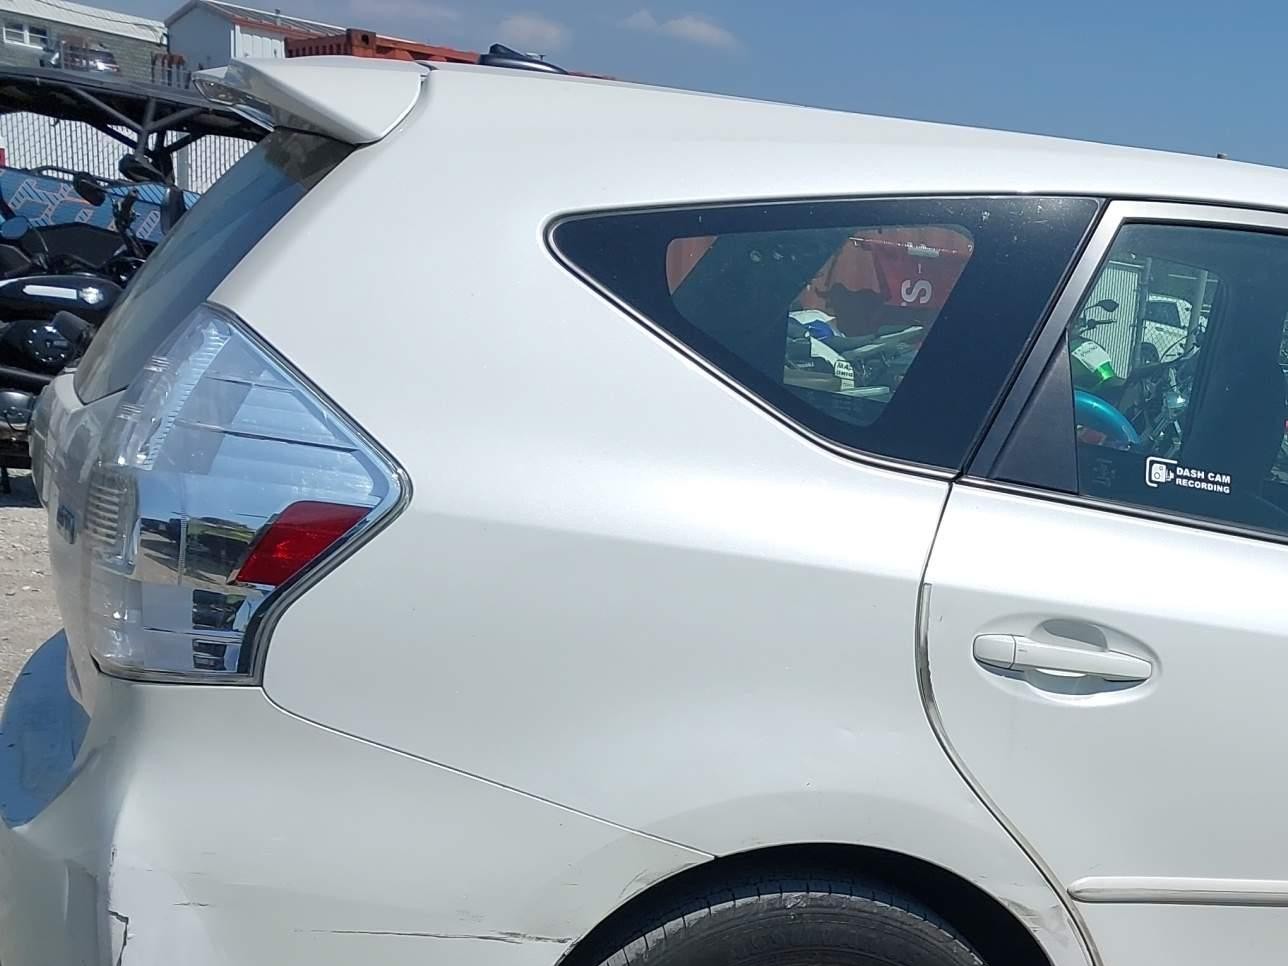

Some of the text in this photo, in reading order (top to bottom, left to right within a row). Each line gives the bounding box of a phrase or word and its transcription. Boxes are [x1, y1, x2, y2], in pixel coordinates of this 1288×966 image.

[1176, 466, 1231, 484] DASH CAM
[1175, 478, 1230, 494] RECORDING
